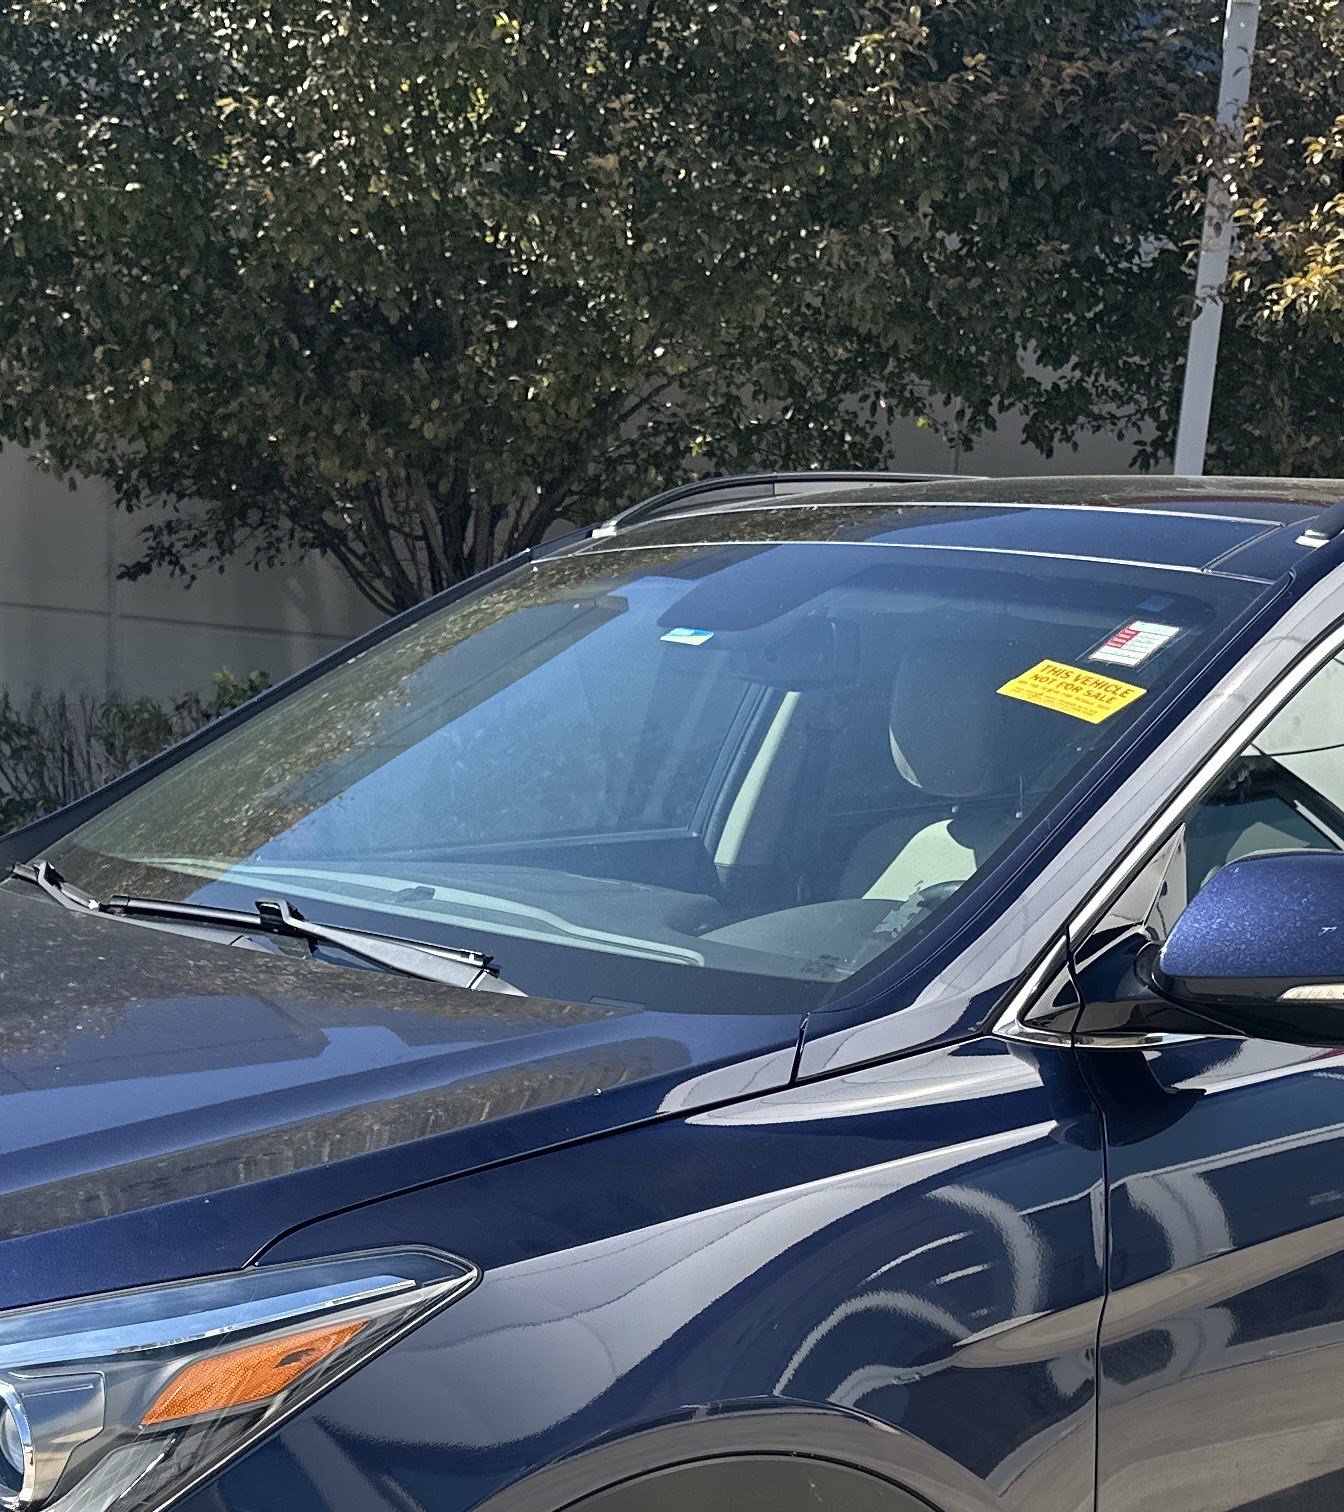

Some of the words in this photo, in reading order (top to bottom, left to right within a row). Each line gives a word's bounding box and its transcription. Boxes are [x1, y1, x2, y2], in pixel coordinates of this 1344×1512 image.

[1031, 673, 1058, 684] NOT
[1056, 681, 1084, 694] FOR
[1084, 689, 1117, 704] SALE
[1039, 664, 1074, 680] THIS
[1074, 673, 1135, 698] VEHICLE
